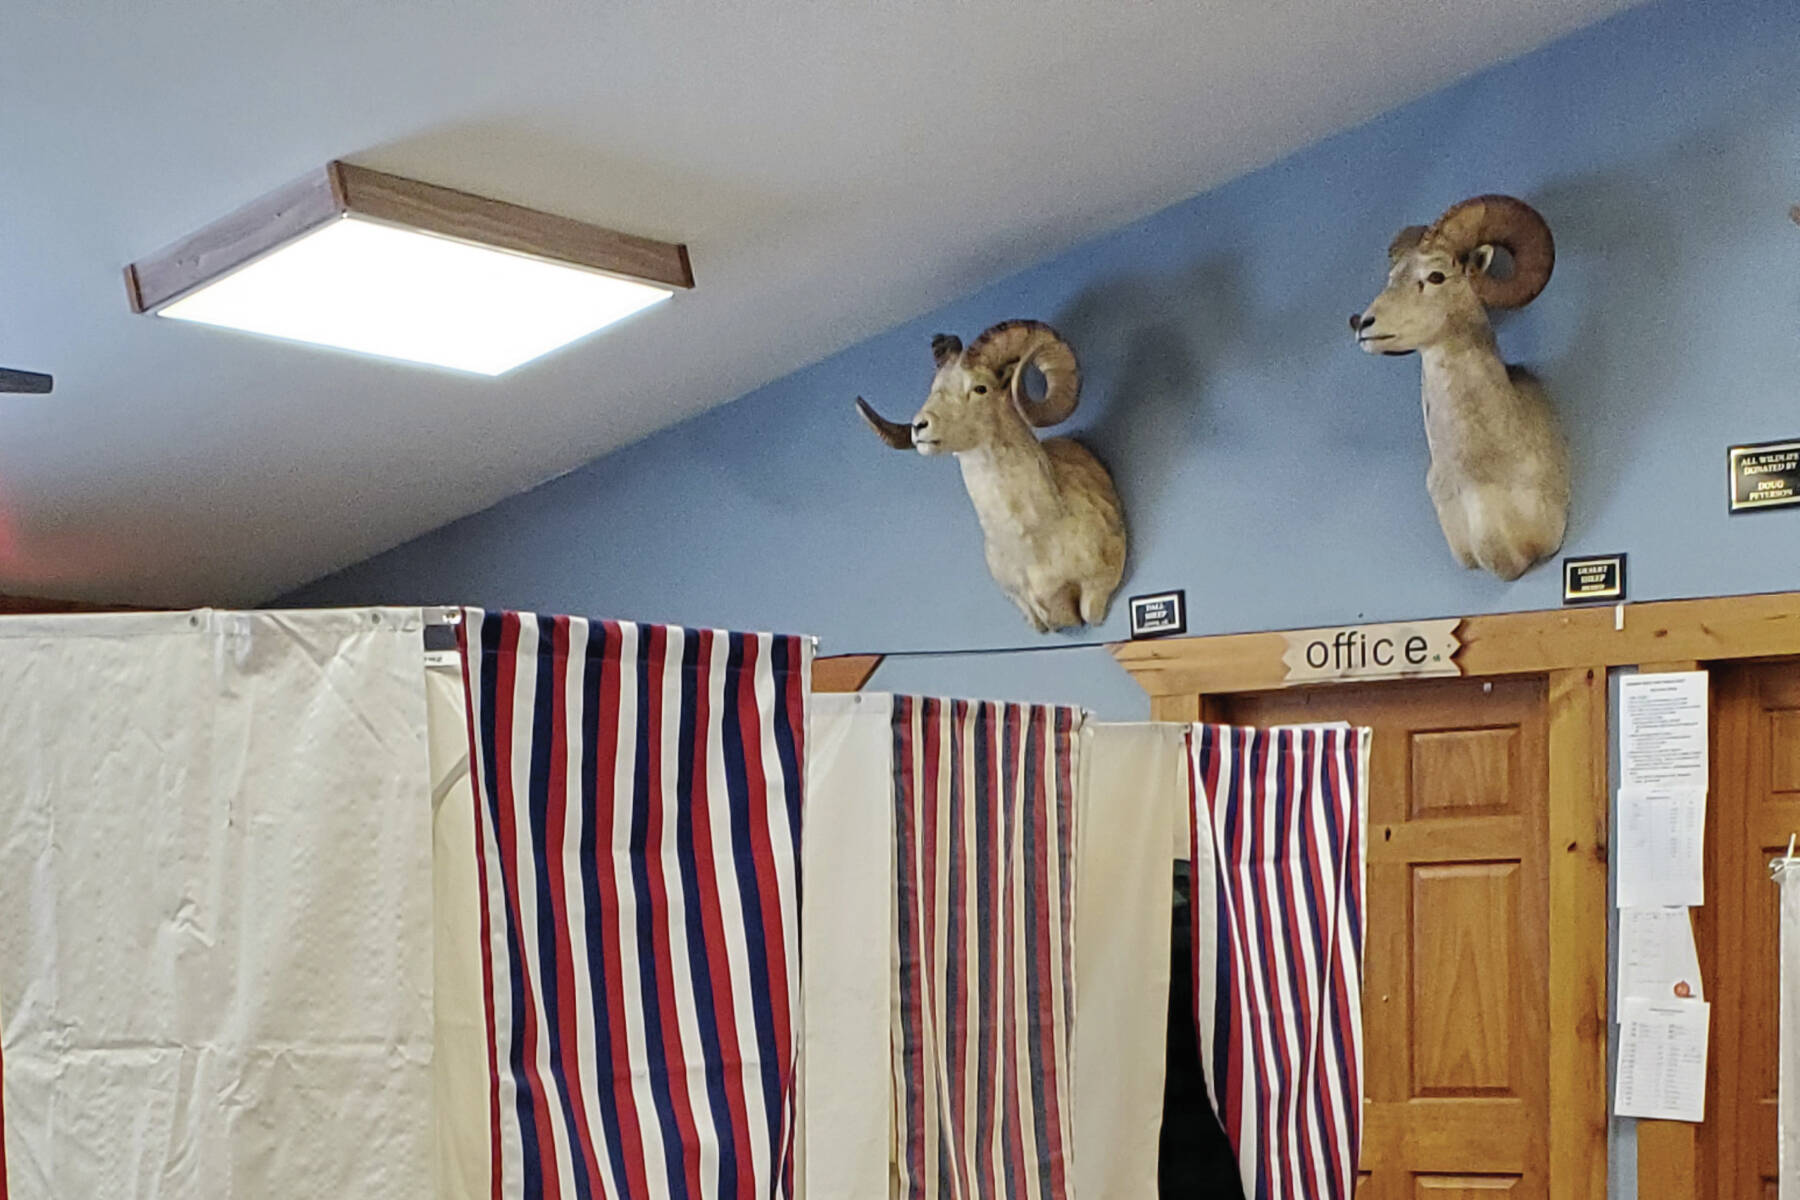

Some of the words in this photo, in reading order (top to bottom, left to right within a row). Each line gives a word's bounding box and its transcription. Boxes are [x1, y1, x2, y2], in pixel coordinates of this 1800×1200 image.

[1741, 456, 1758, 467] ALL
[1744, 463, 1785, 476] DONATED
[1786, 461, 1797, 471] BY
[1758, 480, 1784, 491] DOUG
[1306, 631, 1428, 670] office
